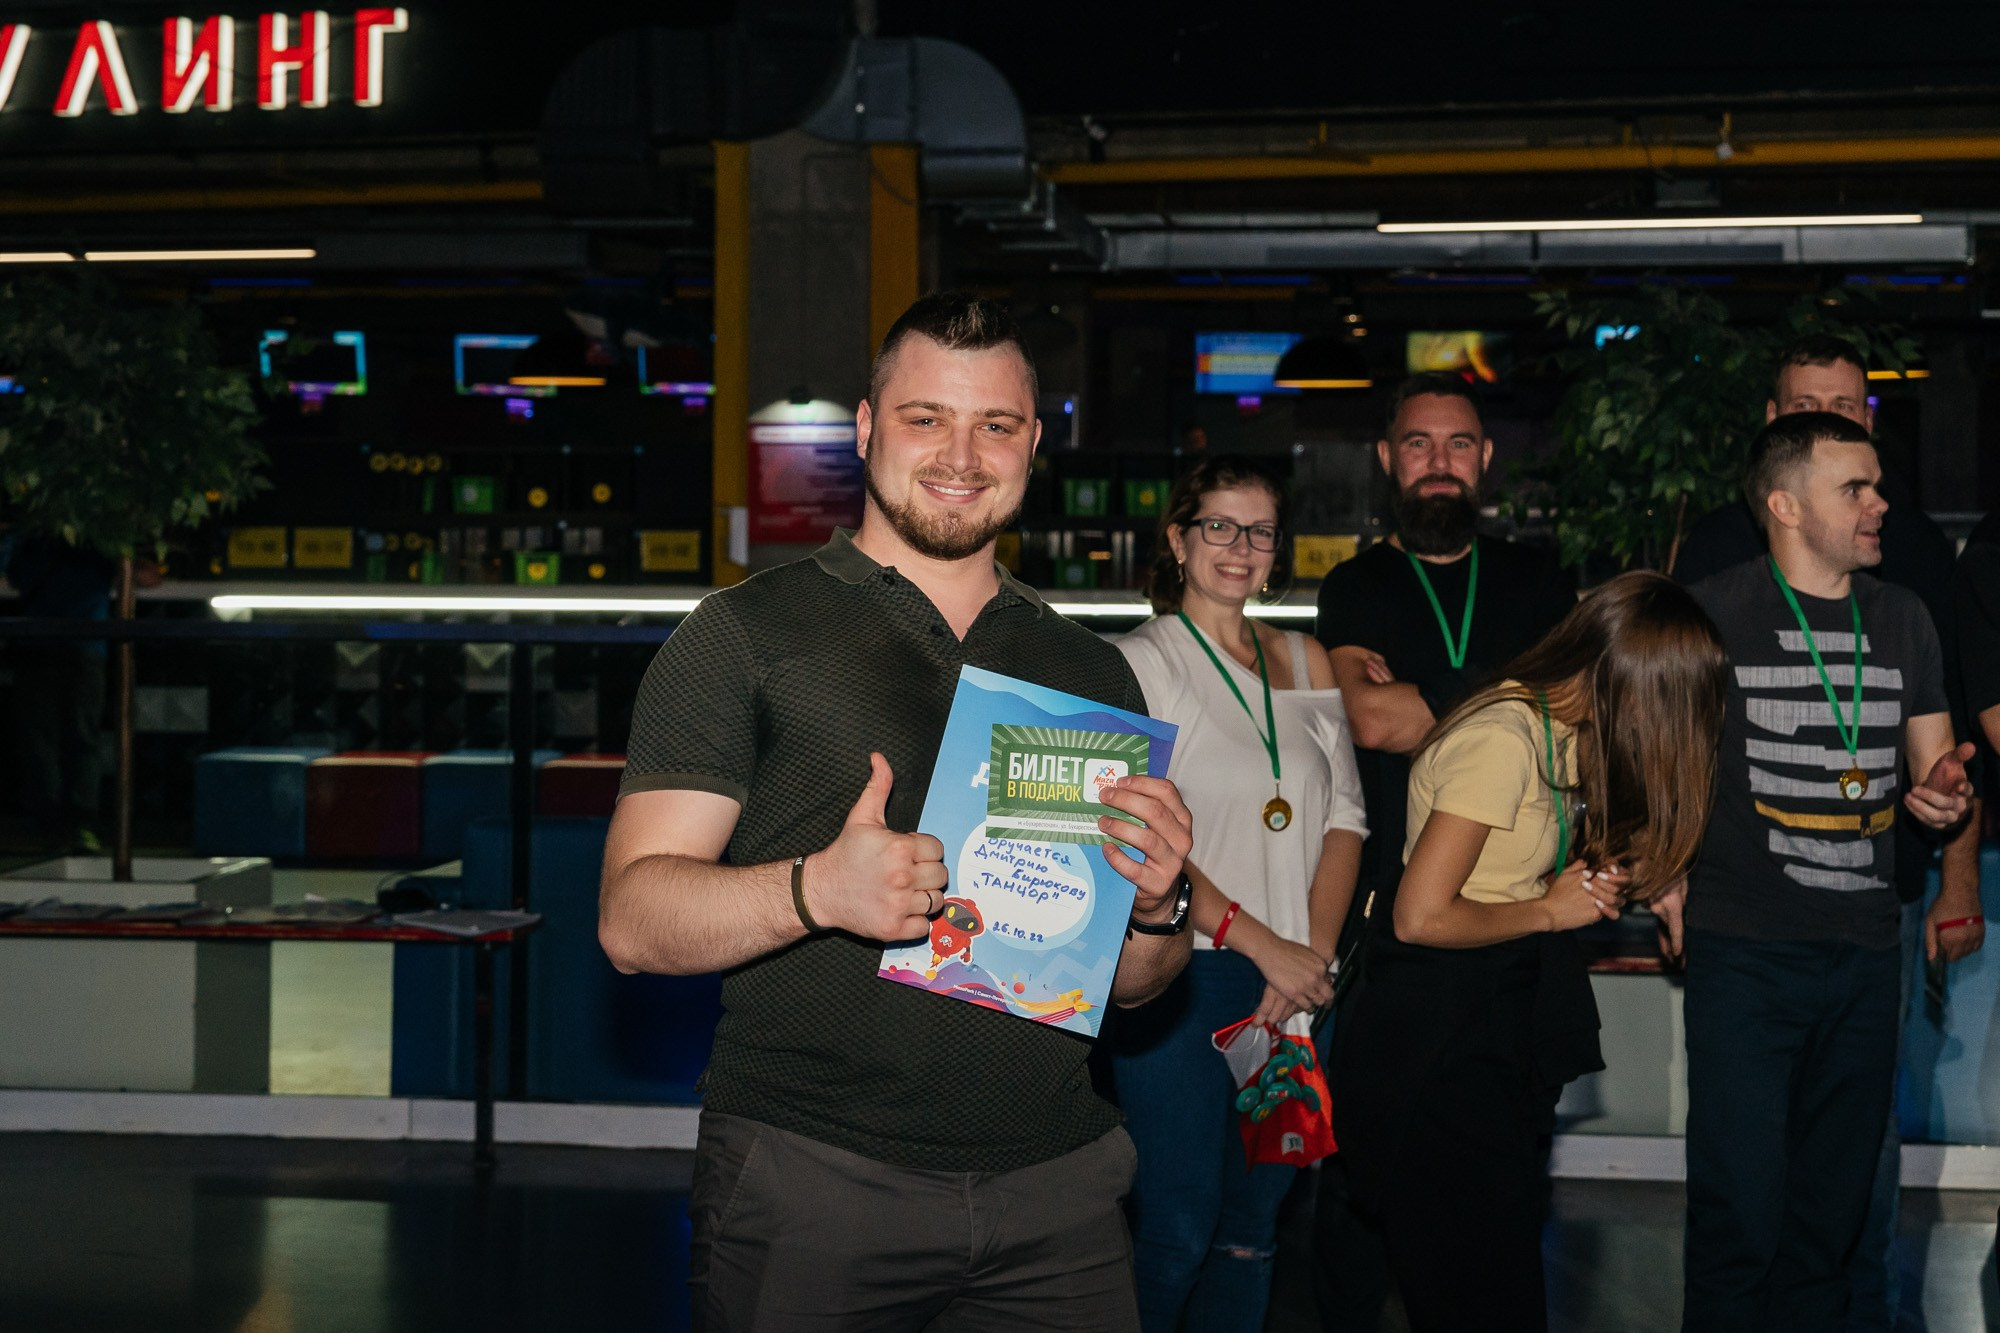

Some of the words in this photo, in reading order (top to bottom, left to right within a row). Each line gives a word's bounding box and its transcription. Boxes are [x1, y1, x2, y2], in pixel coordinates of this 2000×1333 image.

[1008, 752, 1084, 785] БИЛЕТ
[1007, 780, 1017, 798] В
[1018, 781, 1082, 803] ПОДАРОК
[974, 843, 1049, 873] Дмитрию
[1011, 868, 1087, 901] Бирюкову
